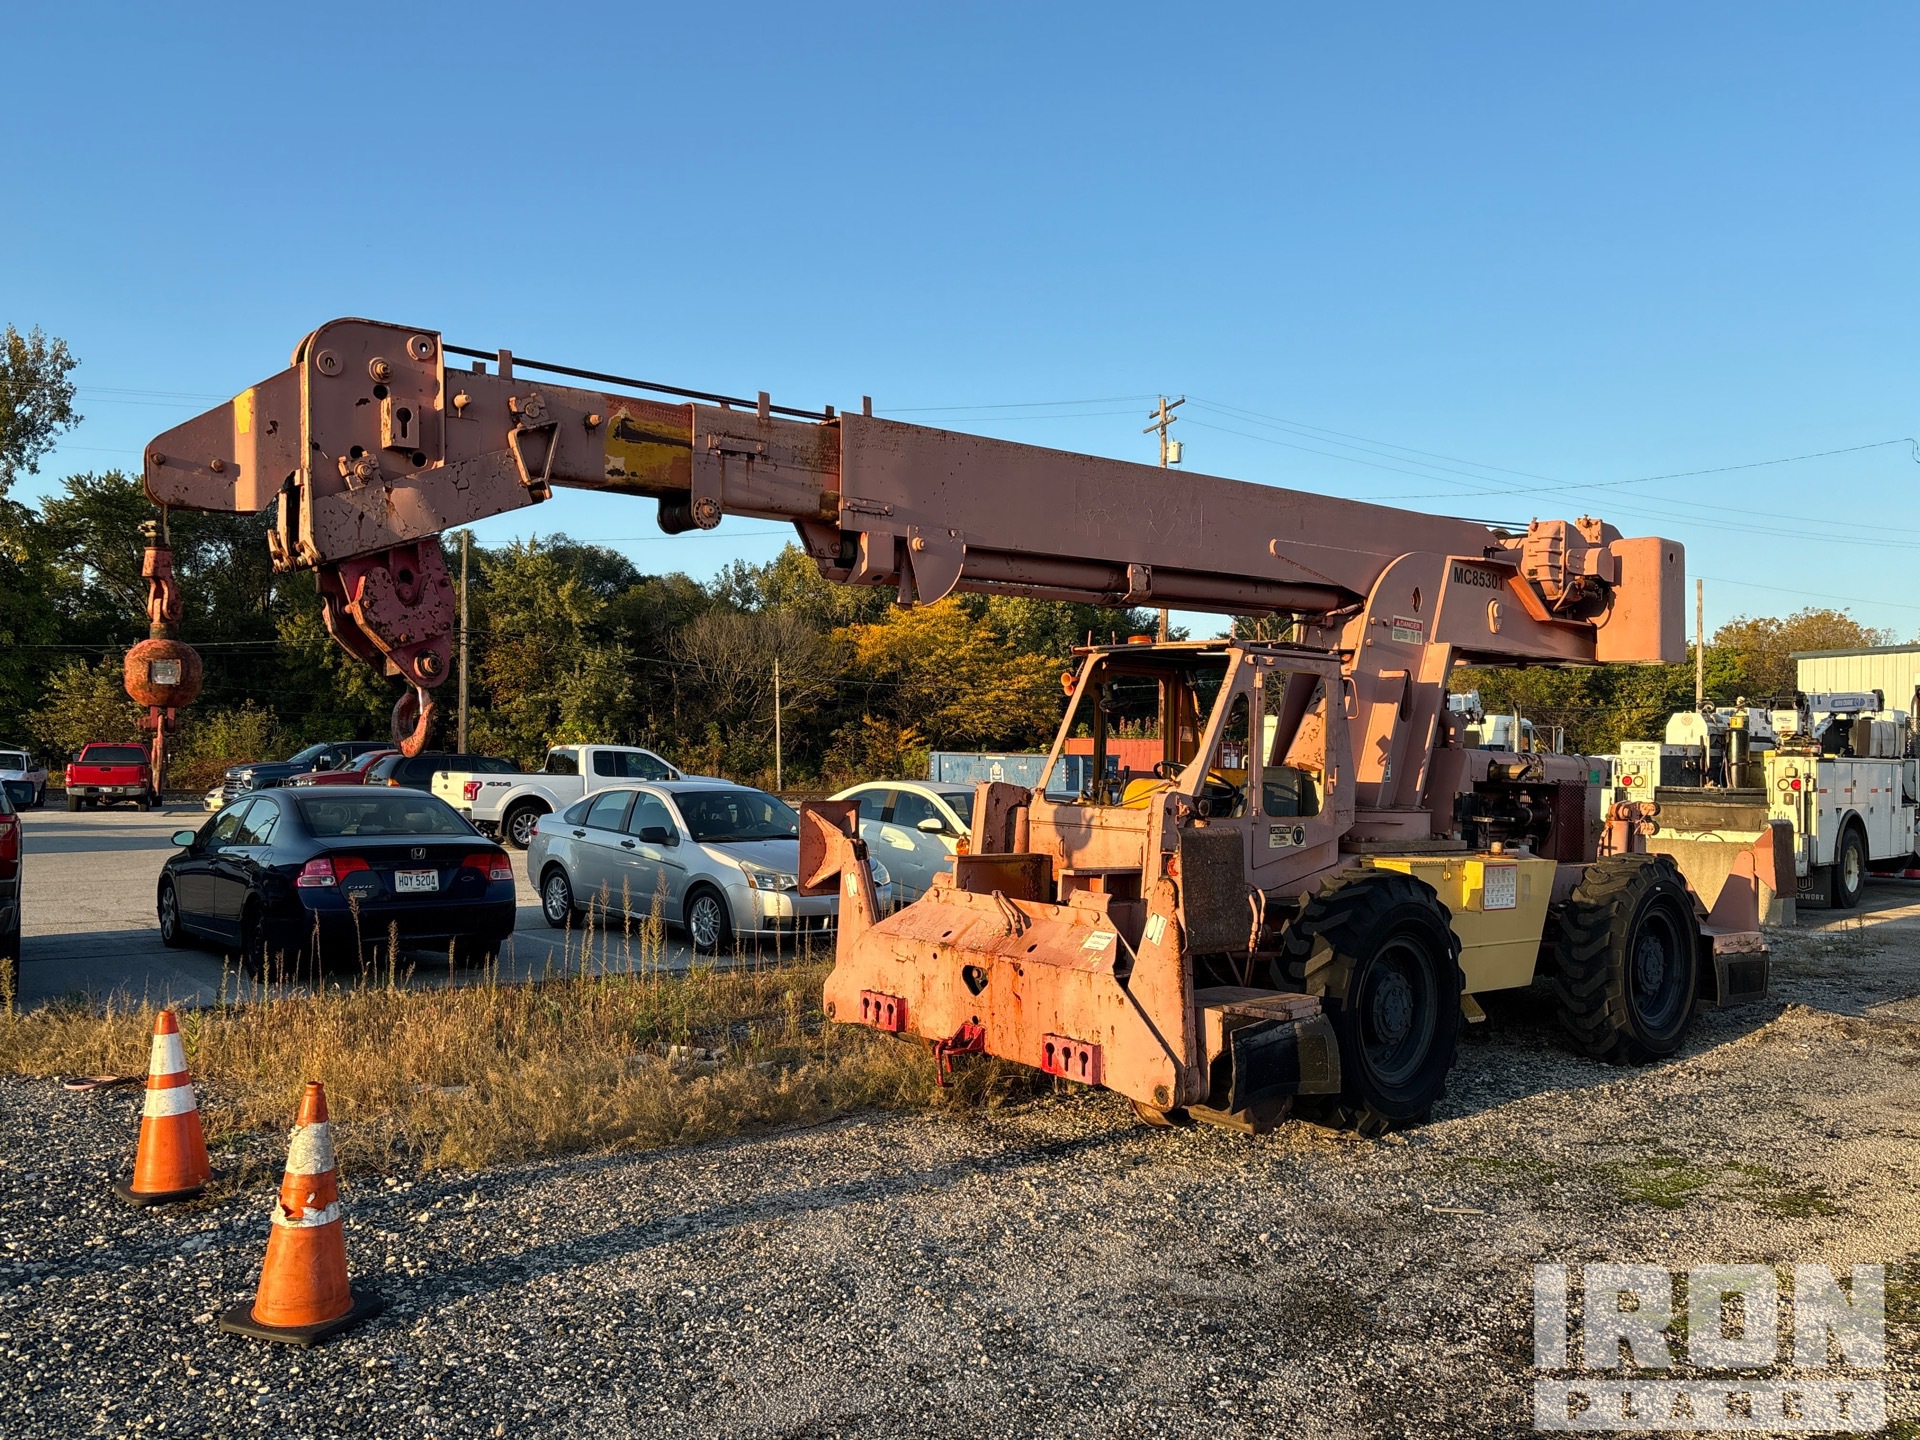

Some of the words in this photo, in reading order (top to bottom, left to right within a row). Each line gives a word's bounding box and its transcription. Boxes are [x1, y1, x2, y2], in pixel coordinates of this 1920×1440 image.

[1454, 567, 1504, 592] MC85301
[1400, 620, 1421, 630] DANGER
[415, 874, 436, 886] 5204
[1795, 892, 1825, 901] CKWORX
